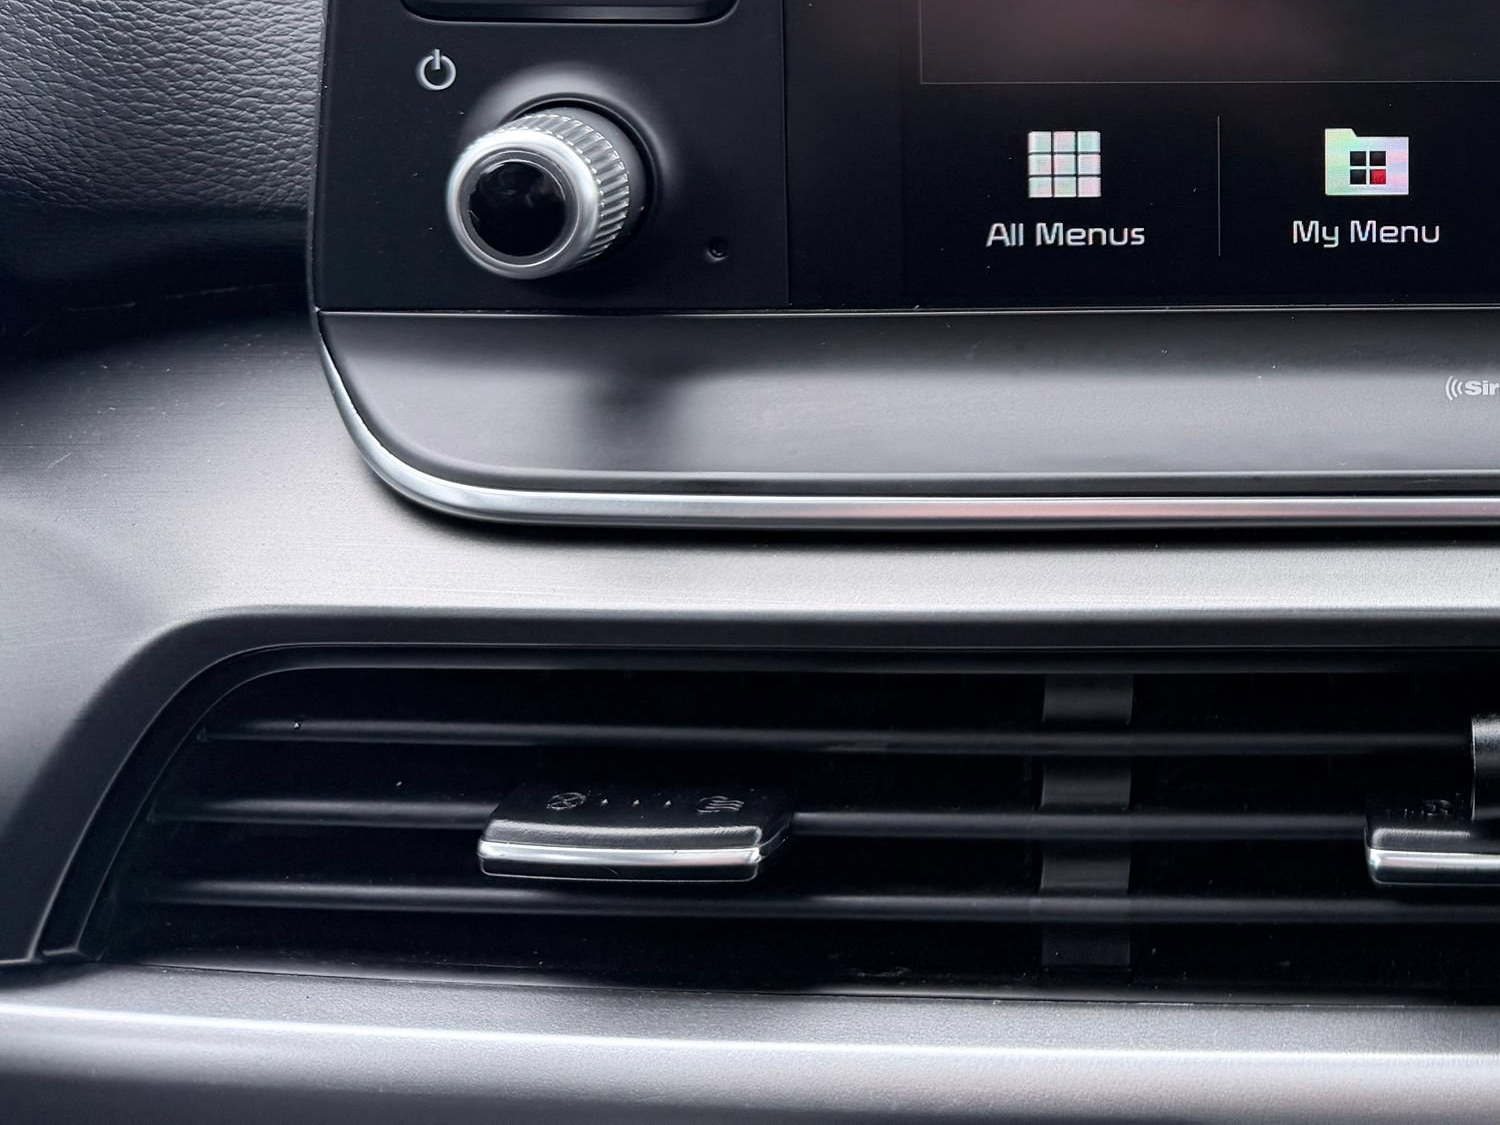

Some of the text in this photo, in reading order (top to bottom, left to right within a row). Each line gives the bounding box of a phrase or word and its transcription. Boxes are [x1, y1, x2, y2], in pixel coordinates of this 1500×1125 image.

[986, 222, 1145, 247] All Menus
[1292, 220, 1440, 248] My Menu
